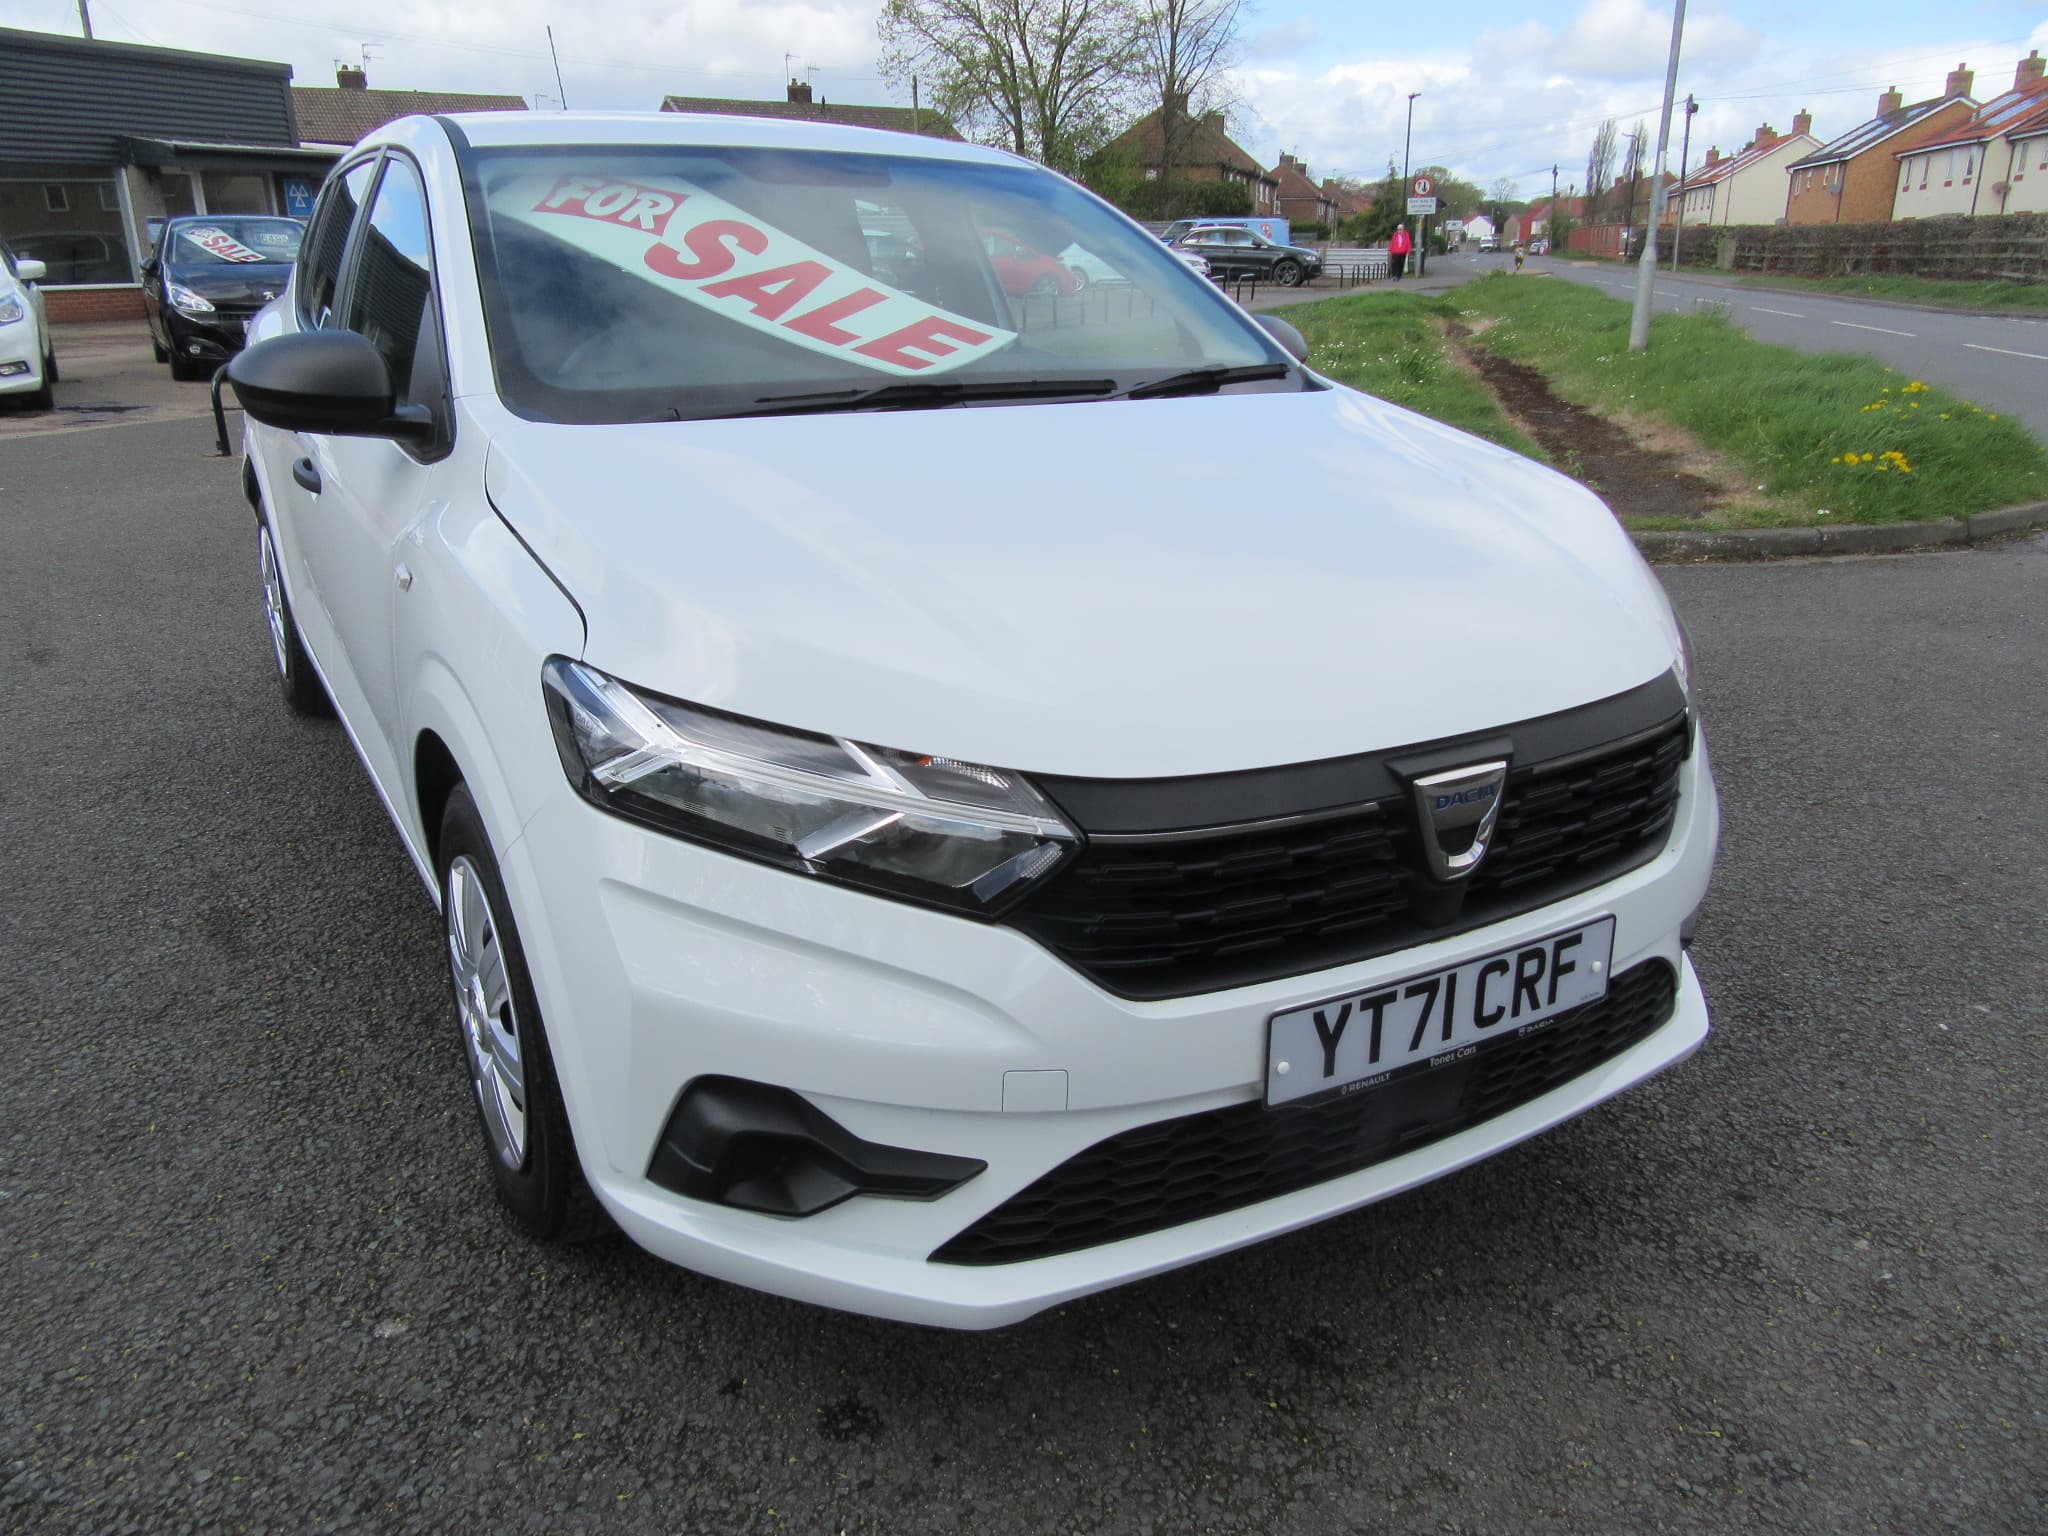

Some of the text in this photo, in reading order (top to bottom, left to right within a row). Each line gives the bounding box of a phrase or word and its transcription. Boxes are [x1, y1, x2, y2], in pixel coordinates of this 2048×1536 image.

[202, 235, 260, 262] SALE
[546, 177, 994, 371] FOR SALE
[1435, 784, 1495, 810] DACIA
[1473, 933, 1584, 1029] CRF
[1430, 1053, 1455, 1067] Tones
[1457, 1045, 1477, 1058] Cars
[1348, 1072, 1391, 1093] RENAULT
